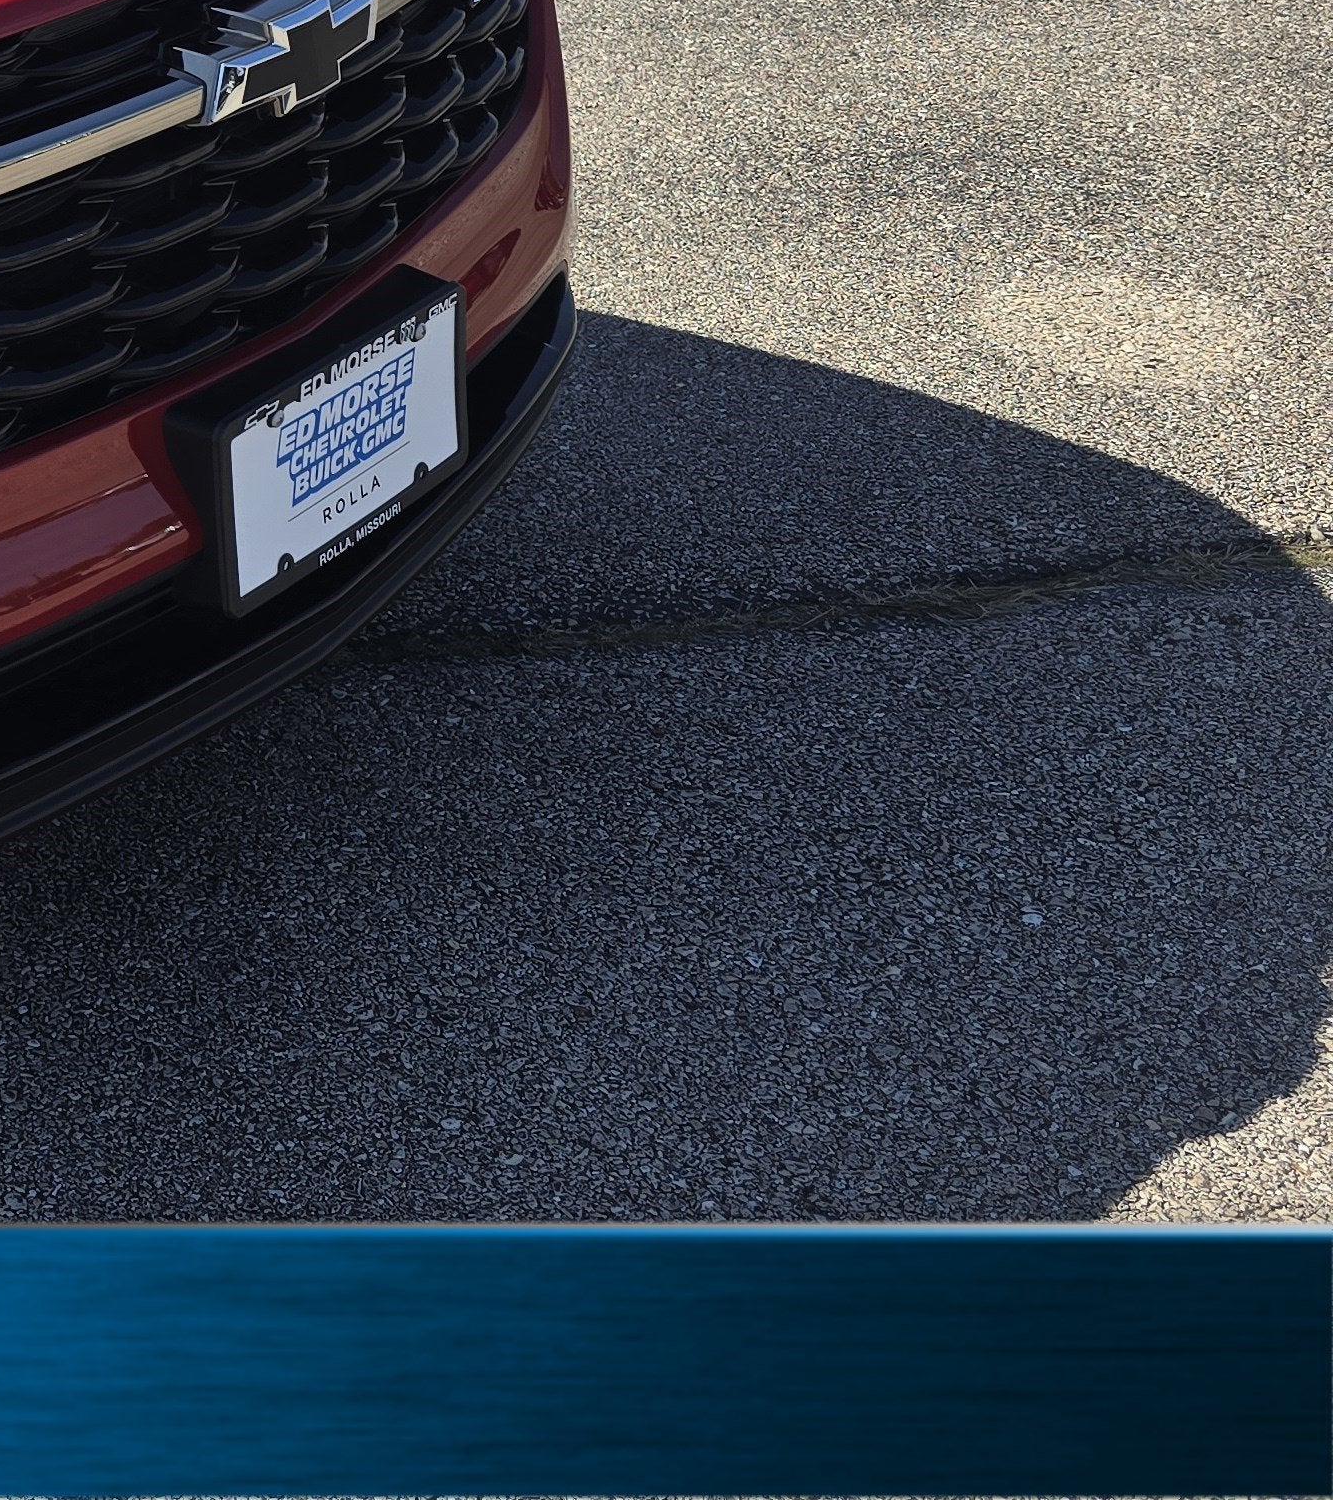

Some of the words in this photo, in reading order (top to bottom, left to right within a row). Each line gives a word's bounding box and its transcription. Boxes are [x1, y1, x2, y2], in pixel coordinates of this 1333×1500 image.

[300, 372, 326, 401] ED
[330, 329, 396, 385] MORSE
[428, 292, 458, 321] GMC
[278, 411, 317, 459] ED
[318, 353, 415, 435] MORSE
[290, 385, 406, 475] CHEVROLET
[318, 536, 355, 567] ROLLA,
[355, 501, 402, 542] MISSOURI
[322, 475, 381, 524] ROLLA
